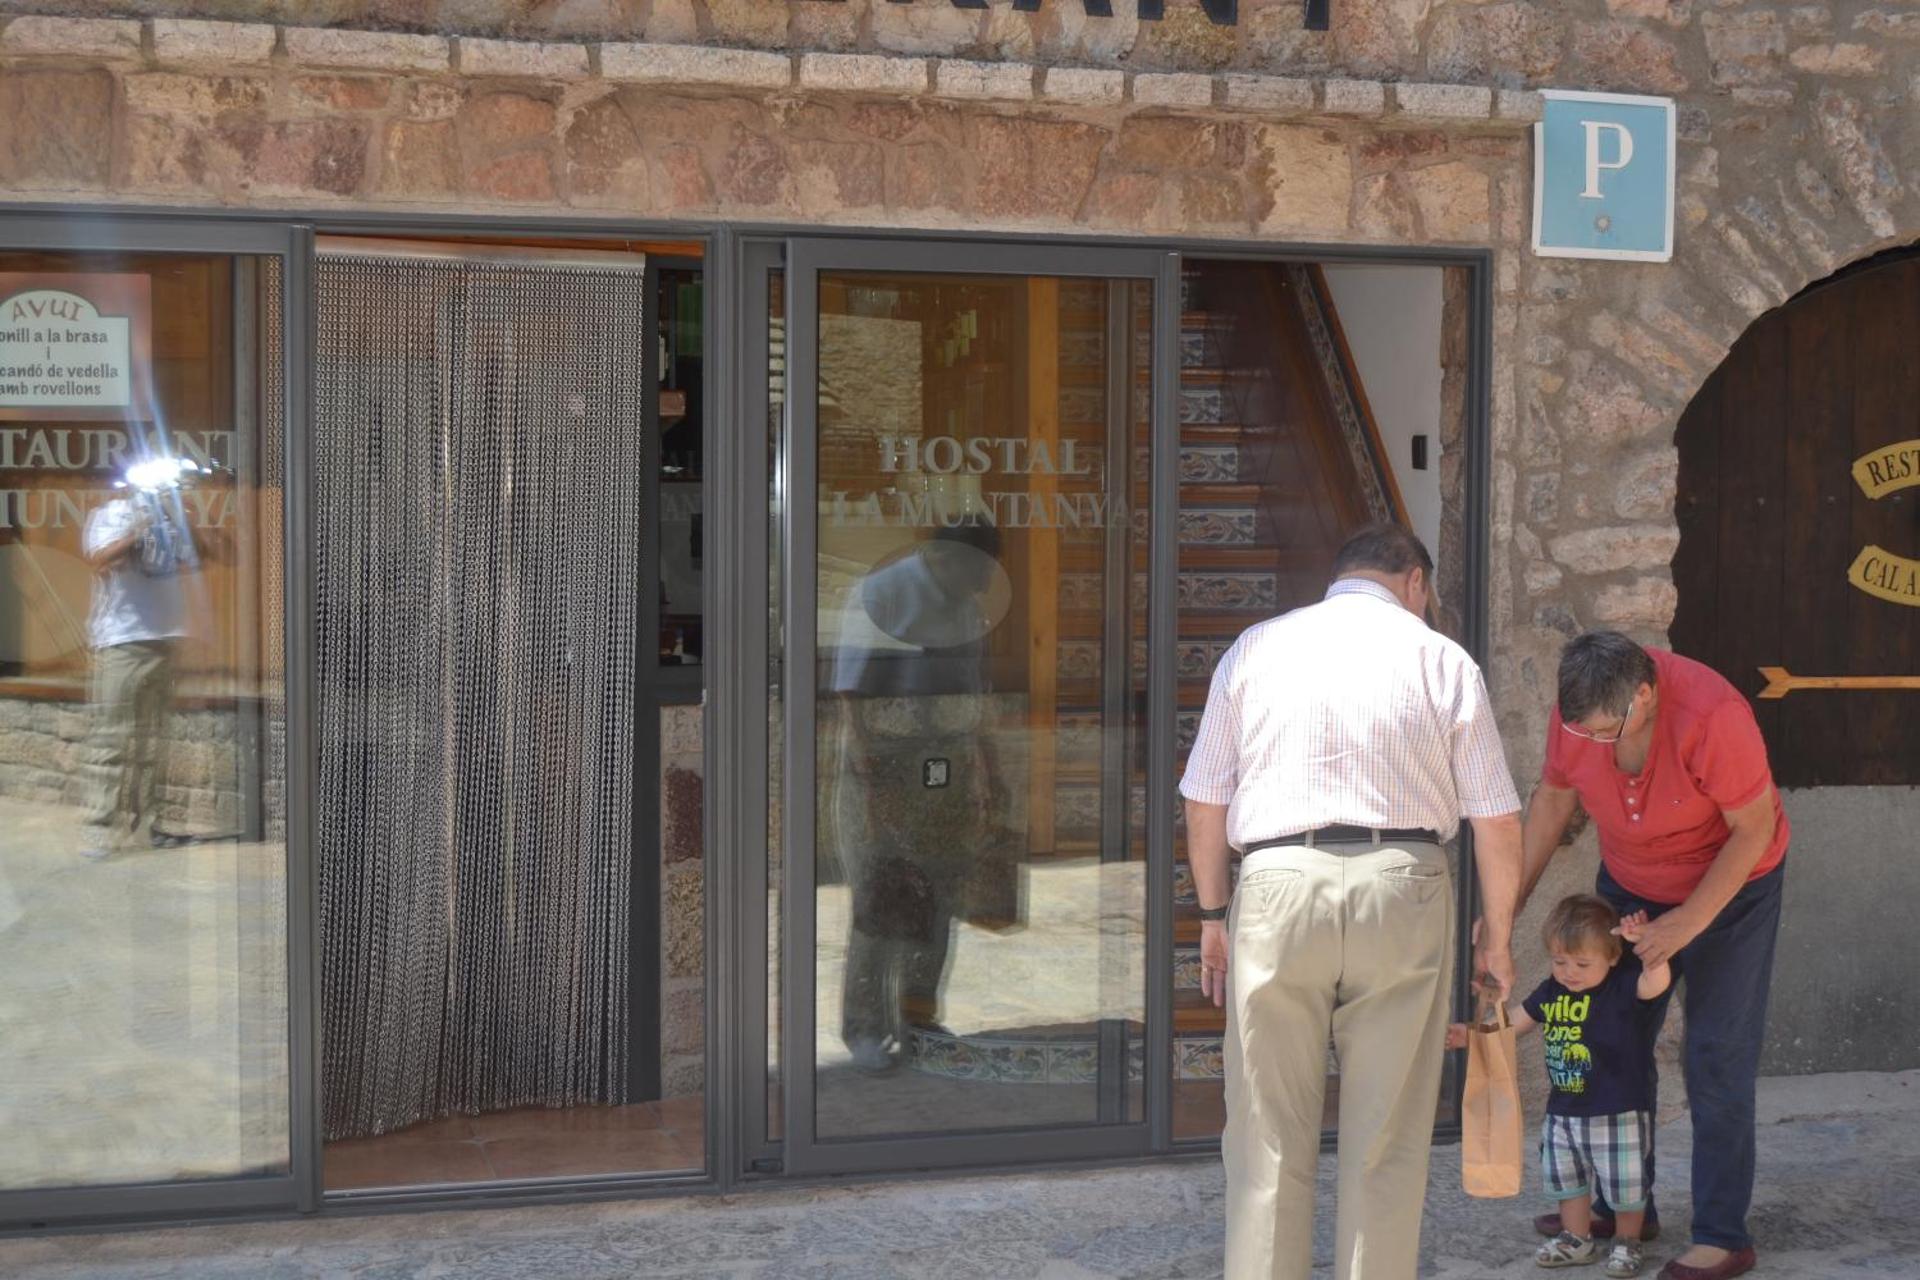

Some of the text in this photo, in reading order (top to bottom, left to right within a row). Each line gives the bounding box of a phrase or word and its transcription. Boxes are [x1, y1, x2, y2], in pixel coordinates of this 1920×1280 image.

[1578, 120, 1634, 199] P
[34, 332, 43, 343] a
[48, 328, 61, 343] la
[66, 329, 109, 343] brasa
[47, 363, 64, 378] de
[67, 363, 119, 378] vedella
[0, 381, 102, 396] amb rovellons
[878, 435, 1091, 475] HOSTAL
[832, 491, 1138, 529] LA MUNTANYA
